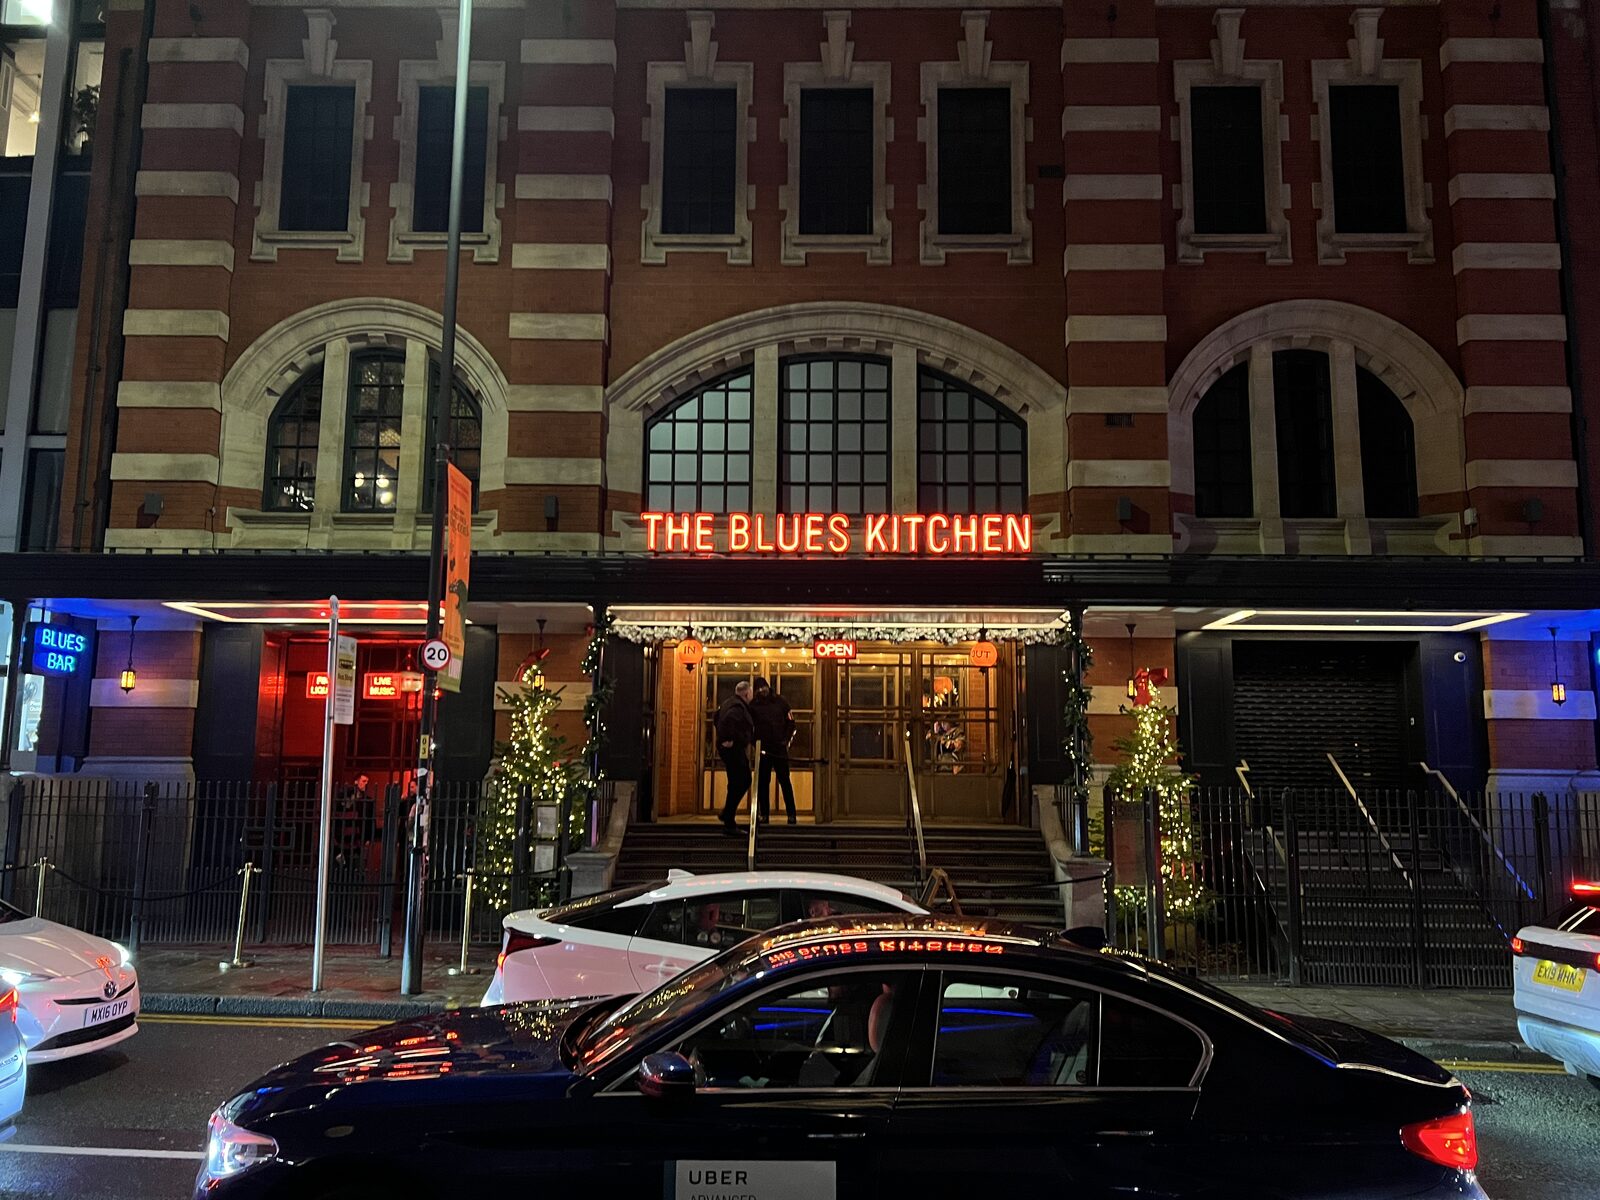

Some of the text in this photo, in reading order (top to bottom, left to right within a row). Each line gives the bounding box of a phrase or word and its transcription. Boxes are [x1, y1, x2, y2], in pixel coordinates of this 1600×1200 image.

[640, 512, 1033, 554] THE BLUES KITCHEN
[41, 628, 86, 652] BLUES
[426, 647, 447, 662] 20
[683, 645, 696, 655] IN
[816, 643, 853, 657] OPEN
[971, 650, 991, 659] OUT
[47, 652, 76, 673] BAR
[372, 676, 392, 686] LIVE
[310, 685, 329, 695] LIQU
[369, 685, 396, 696] MUSIC
[91, 1000, 128, 1023] MX16 OYP
[688, 1170, 748, 1185] UBER
